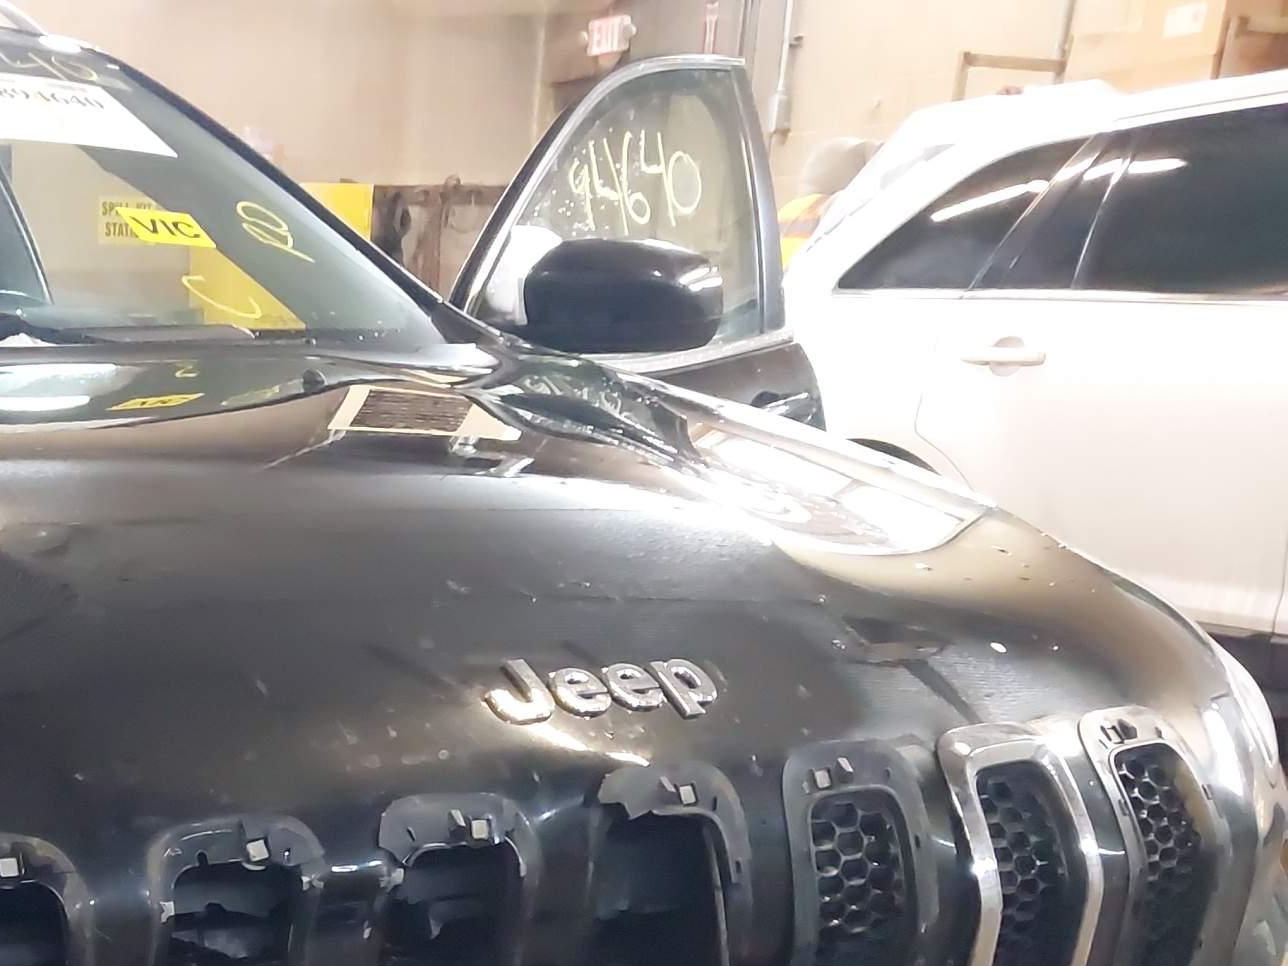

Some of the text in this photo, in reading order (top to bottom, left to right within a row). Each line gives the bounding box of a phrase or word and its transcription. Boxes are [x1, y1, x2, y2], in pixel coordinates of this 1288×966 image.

[569, 129, 702, 236] 94640
[129, 215, 201, 239] VIC
[481, 658, 717, 725] Jeep
